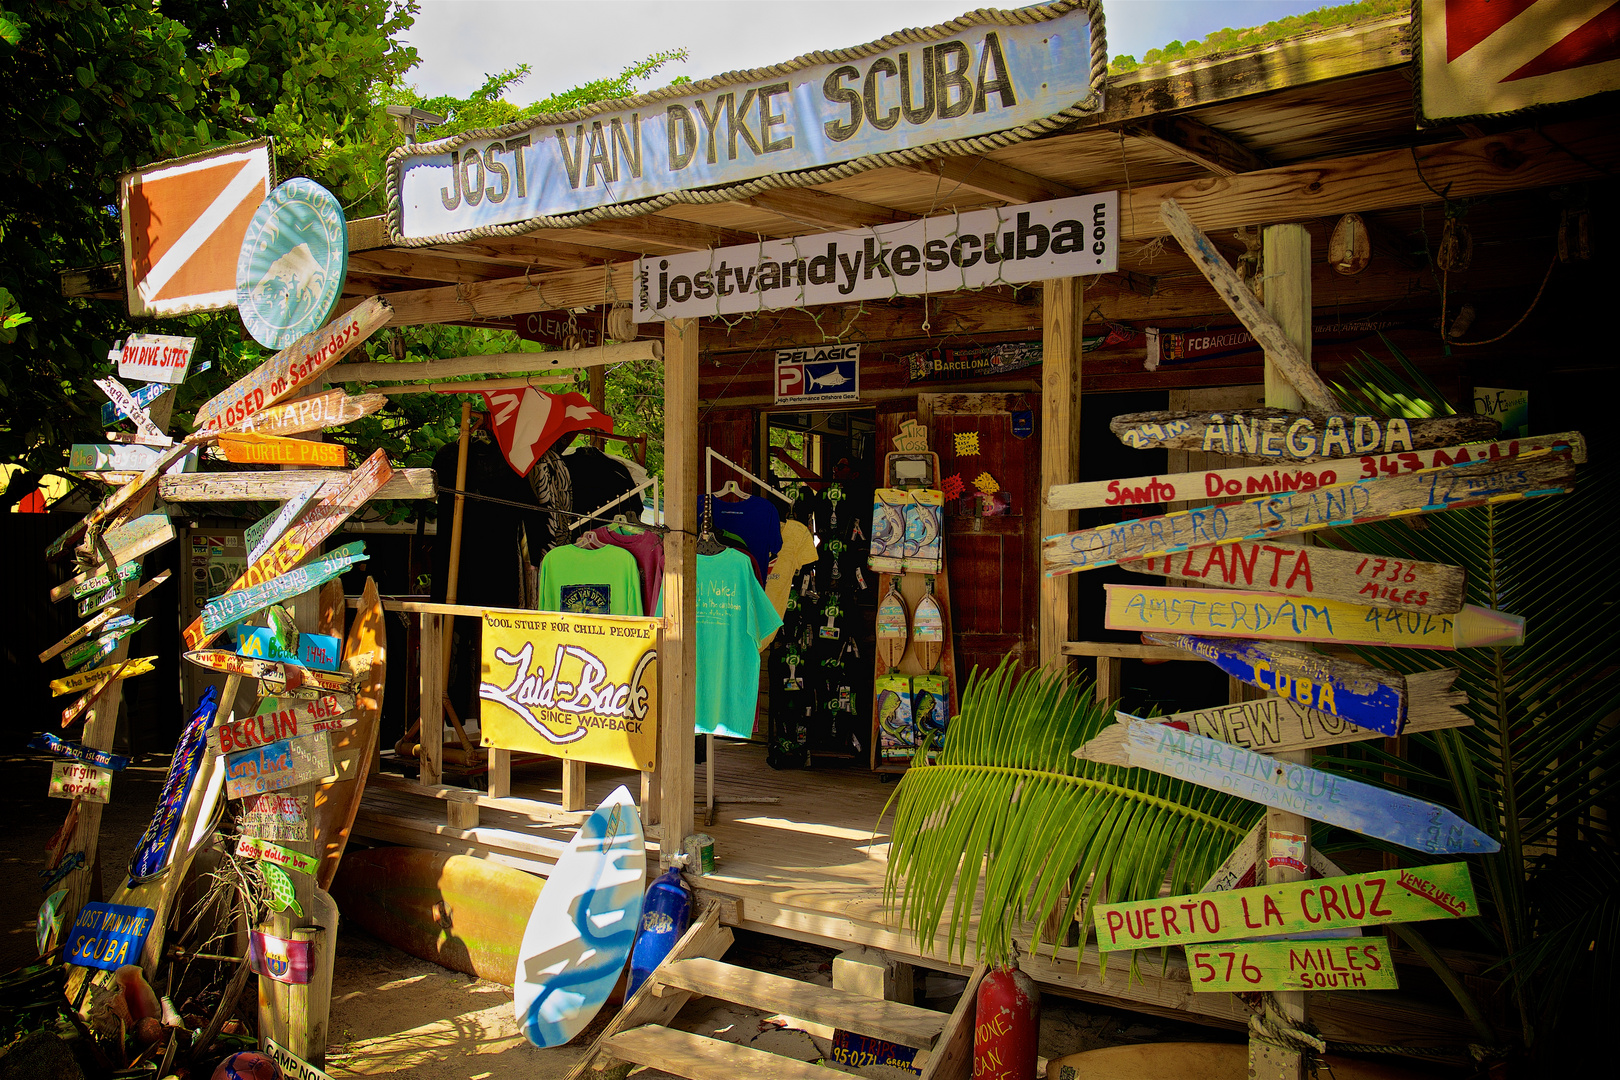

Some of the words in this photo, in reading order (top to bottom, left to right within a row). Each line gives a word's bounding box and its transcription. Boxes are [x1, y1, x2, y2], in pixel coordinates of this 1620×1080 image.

[440, 136, 530, 211] JOST
[556, 112, 642, 190] VAN
[667, 82, 793, 172] DYKE
[823, 32, 1016, 142] SCUBA
[241, 220, 263, 257] BVI
[268, 182, 342, 243] ECO-TOURS
[656, 212, 1086, 310] jostvandykescuba
[1093, 202, 1107, 265] .com
[309, 270, 340, 330] Islands
[527, 314, 596, 345] CLEARCE
[122, 345, 139, 364] BVI
[138, 346, 160, 366] DIVE
[160, 346, 188, 368] SITES
[778, 346, 857, 365] PELAGIC
[934, 358, 990, 371] BARCELONA
[208, 387, 264, 431] CLOSED
[271, 377, 286, 397] on
[289, 320, 360, 386] Saturdays
[242, 395, 365, 434] ANNAPOLIS
[902, 420, 926, 440] TIKI
[895, 435, 927, 451] TOSS
[1202, 413, 1415, 458] ANEGADA
[72, 450, 93, 466] the
[243, 443, 295, 462] TURTLE
[301, 444, 339, 462] PASS
[1070, 507, 1229, 567] SOMBRERO
[1252, 486, 1371, 533] ISLAND
[1142, 543, 1314, 592] LANTA
[1355, 558, 1417, 583] 1736
[204, 595, 235, 623] RIO
[237, 589, 256, 608] DE
[258, 568, 309, 607] JANEIRO
[321, 547, 352, 573] 3198
[1359, 582, 1430, 606] MILES
[488, 618, 512, 628] COOL
[514, 619, 547, 631] STUFF
[551, 622, 570, 633] FOR
[573, 623, 605, 635] CHILL
[610, 626, 651, 639] PEOPLE
[1125, 593, 1334, 635] AMSTERDAM
[201, 654, 226, 664] VICTOR
[240, 634, 263, 657] VA
[226, 662, 245, 673] IDAHO
[486, 641, 657, 728] Laid-Back
[1254, 660, 1337, 715] CUBA
[219, 709, 297, 753] BERLIN
[541, 709, 572, 725] SINCE
[577, 715, 643, 734] WAY-BACK
[1194, 700, 1281, 748] NEW
[50, 741, 83, 760] norman
[85, 749, 112, 765] island
[291, 740, 324, 769] LONDON
[1157, 727, 1347, 804] MARTINIQUE
[62, 764, 97, 781] virgin
[1162, 758, 1213, 780] FORT
[1222, 775, 1240, 791] DE
[1252, 783, 1314, 814] FRANCE
[62, 782, 98, 797] gorda
[239, 841, 263, 858] Soggy
[264, 848, 291, 864] dollar
[293, 855, 308, 870] bar
[1400, 870, 1467, 912] VENEZUELA
[76, 910, 103, 929] JOST
[101, 913, 123, 934] VAN
[120, 916, 149, 938] DYKE
[1107, 899, 1220, 945] PUERTO
[1243, 894, 1284, 928] LA
[1301, 879, 1392, 923] CRUZ
[71, 934, 129, 965] SCUBA
[1195, 952, 1263, 984] 576
[1289, 946, 1382, 972] MILES
[1301, 971, 1367, 989] SOUTH
[266, 1044, 298, 1072] CAMP
[859, 1037, 897, 1058] TRIPS
[974, 1046, 1004, 1077] CAN
